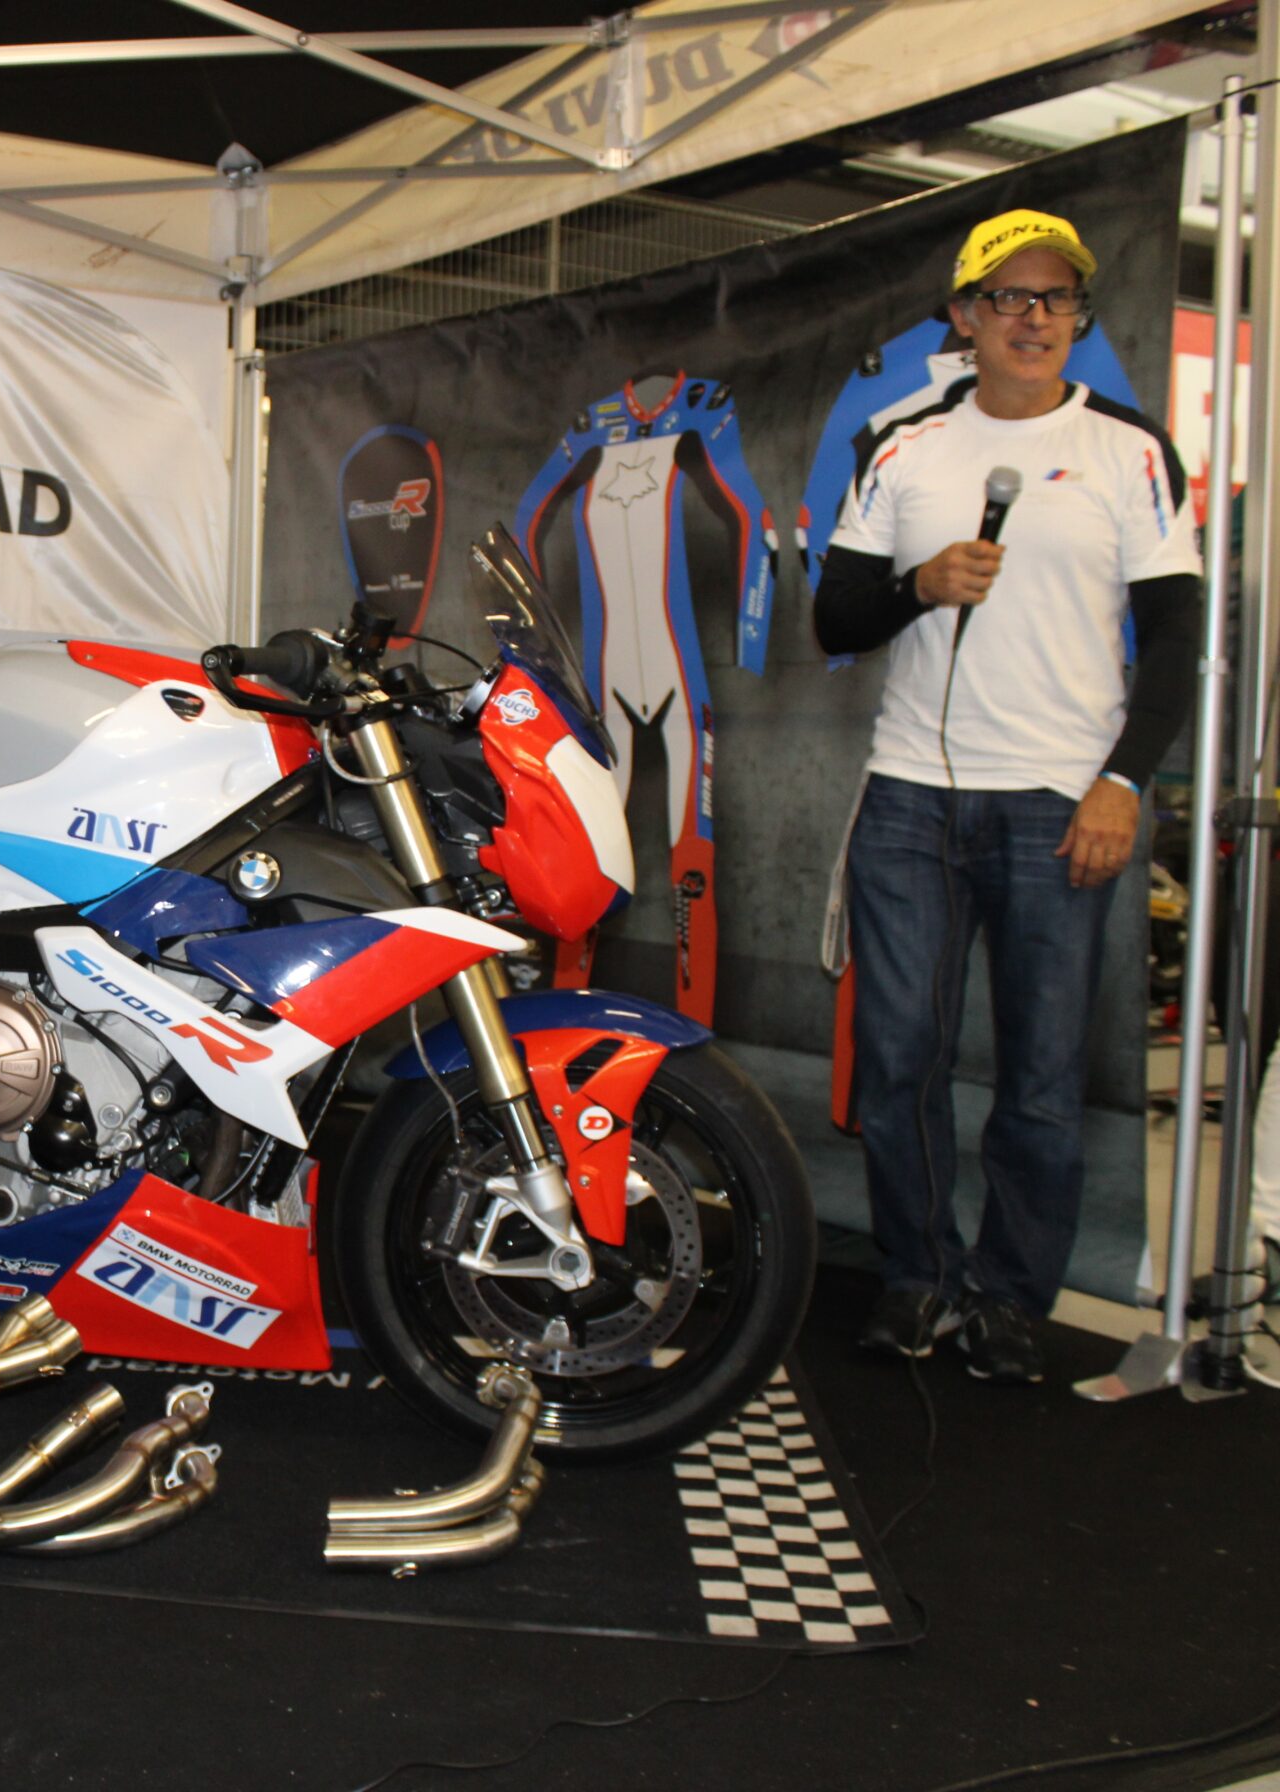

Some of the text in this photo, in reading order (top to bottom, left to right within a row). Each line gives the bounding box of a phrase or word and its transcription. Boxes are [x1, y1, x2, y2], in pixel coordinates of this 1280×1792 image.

[980, 223, 1062, 257] DUNLO
[497, 696, 538, 718] FUCHS
[137, 1240, 252, 1296] BMW MOTORRAD
